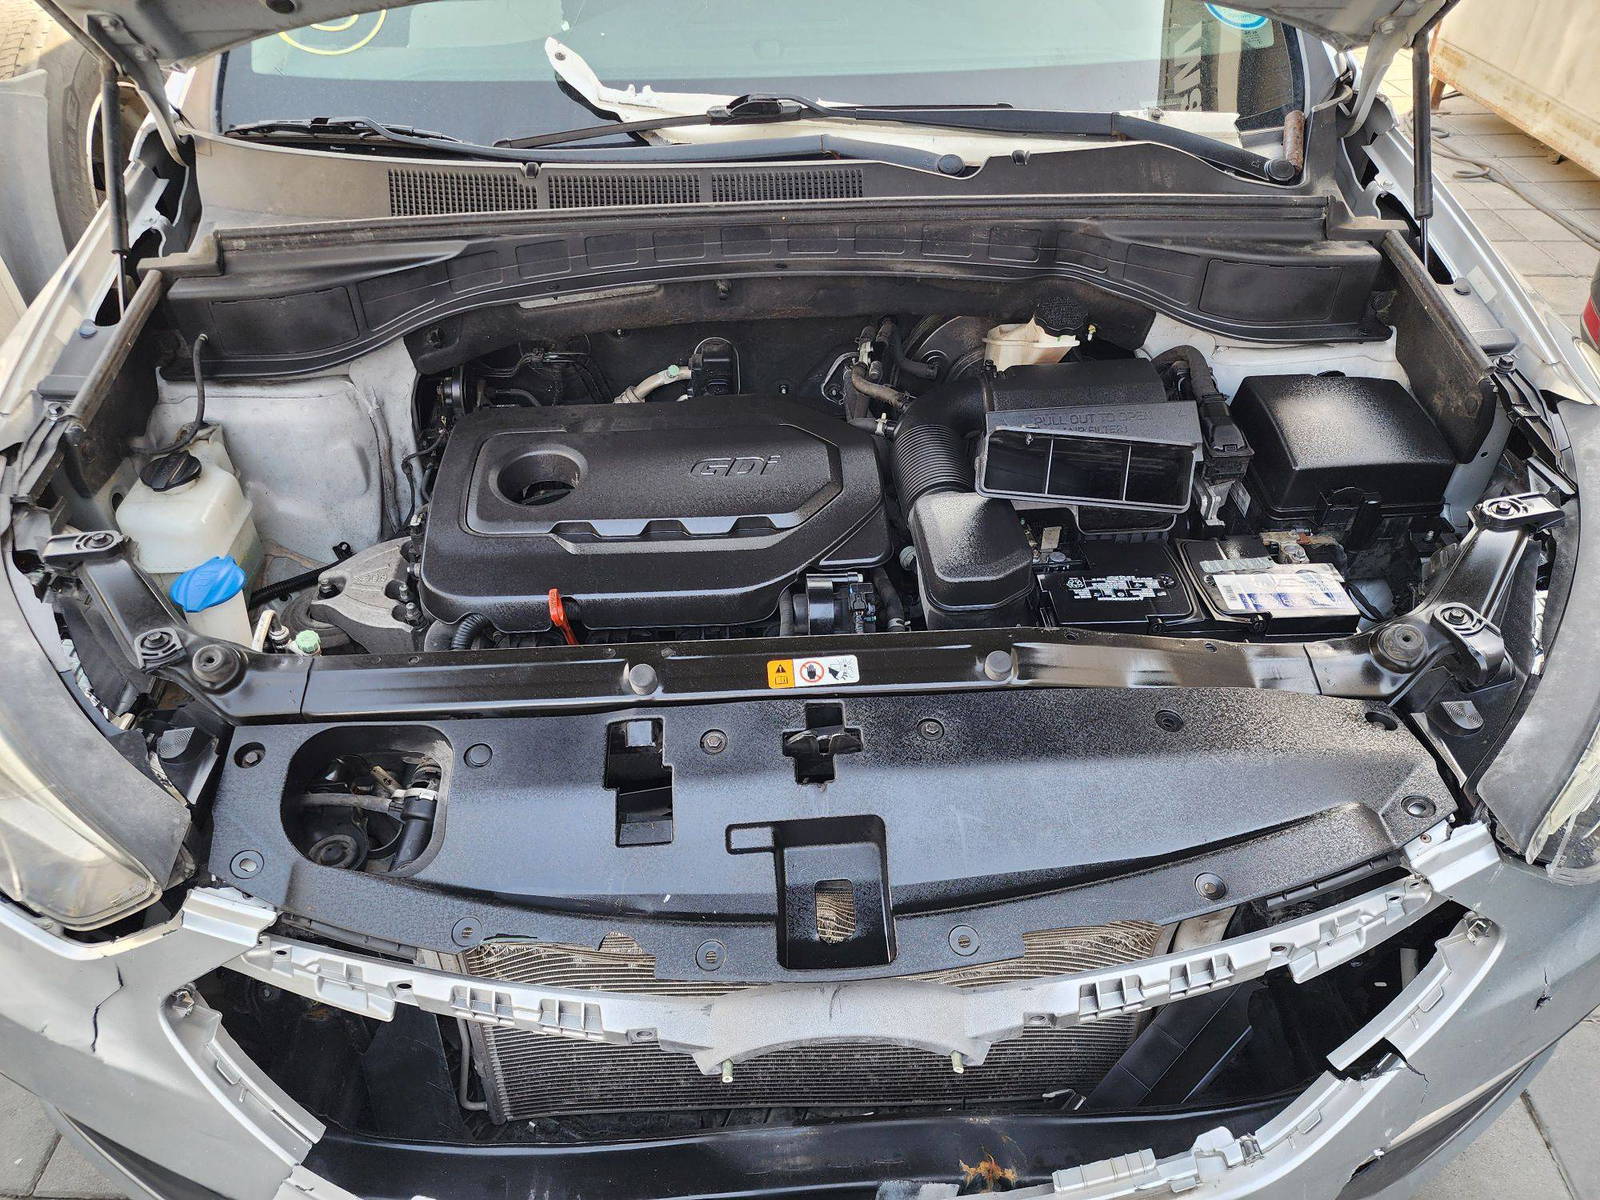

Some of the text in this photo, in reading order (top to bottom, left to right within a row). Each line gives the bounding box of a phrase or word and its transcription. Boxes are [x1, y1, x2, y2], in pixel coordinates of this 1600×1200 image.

[1035, 414, 1067, 426] PULL
[1069, 413, 1096, 424] OUT
[1098, 411, 1115, 422] TO
